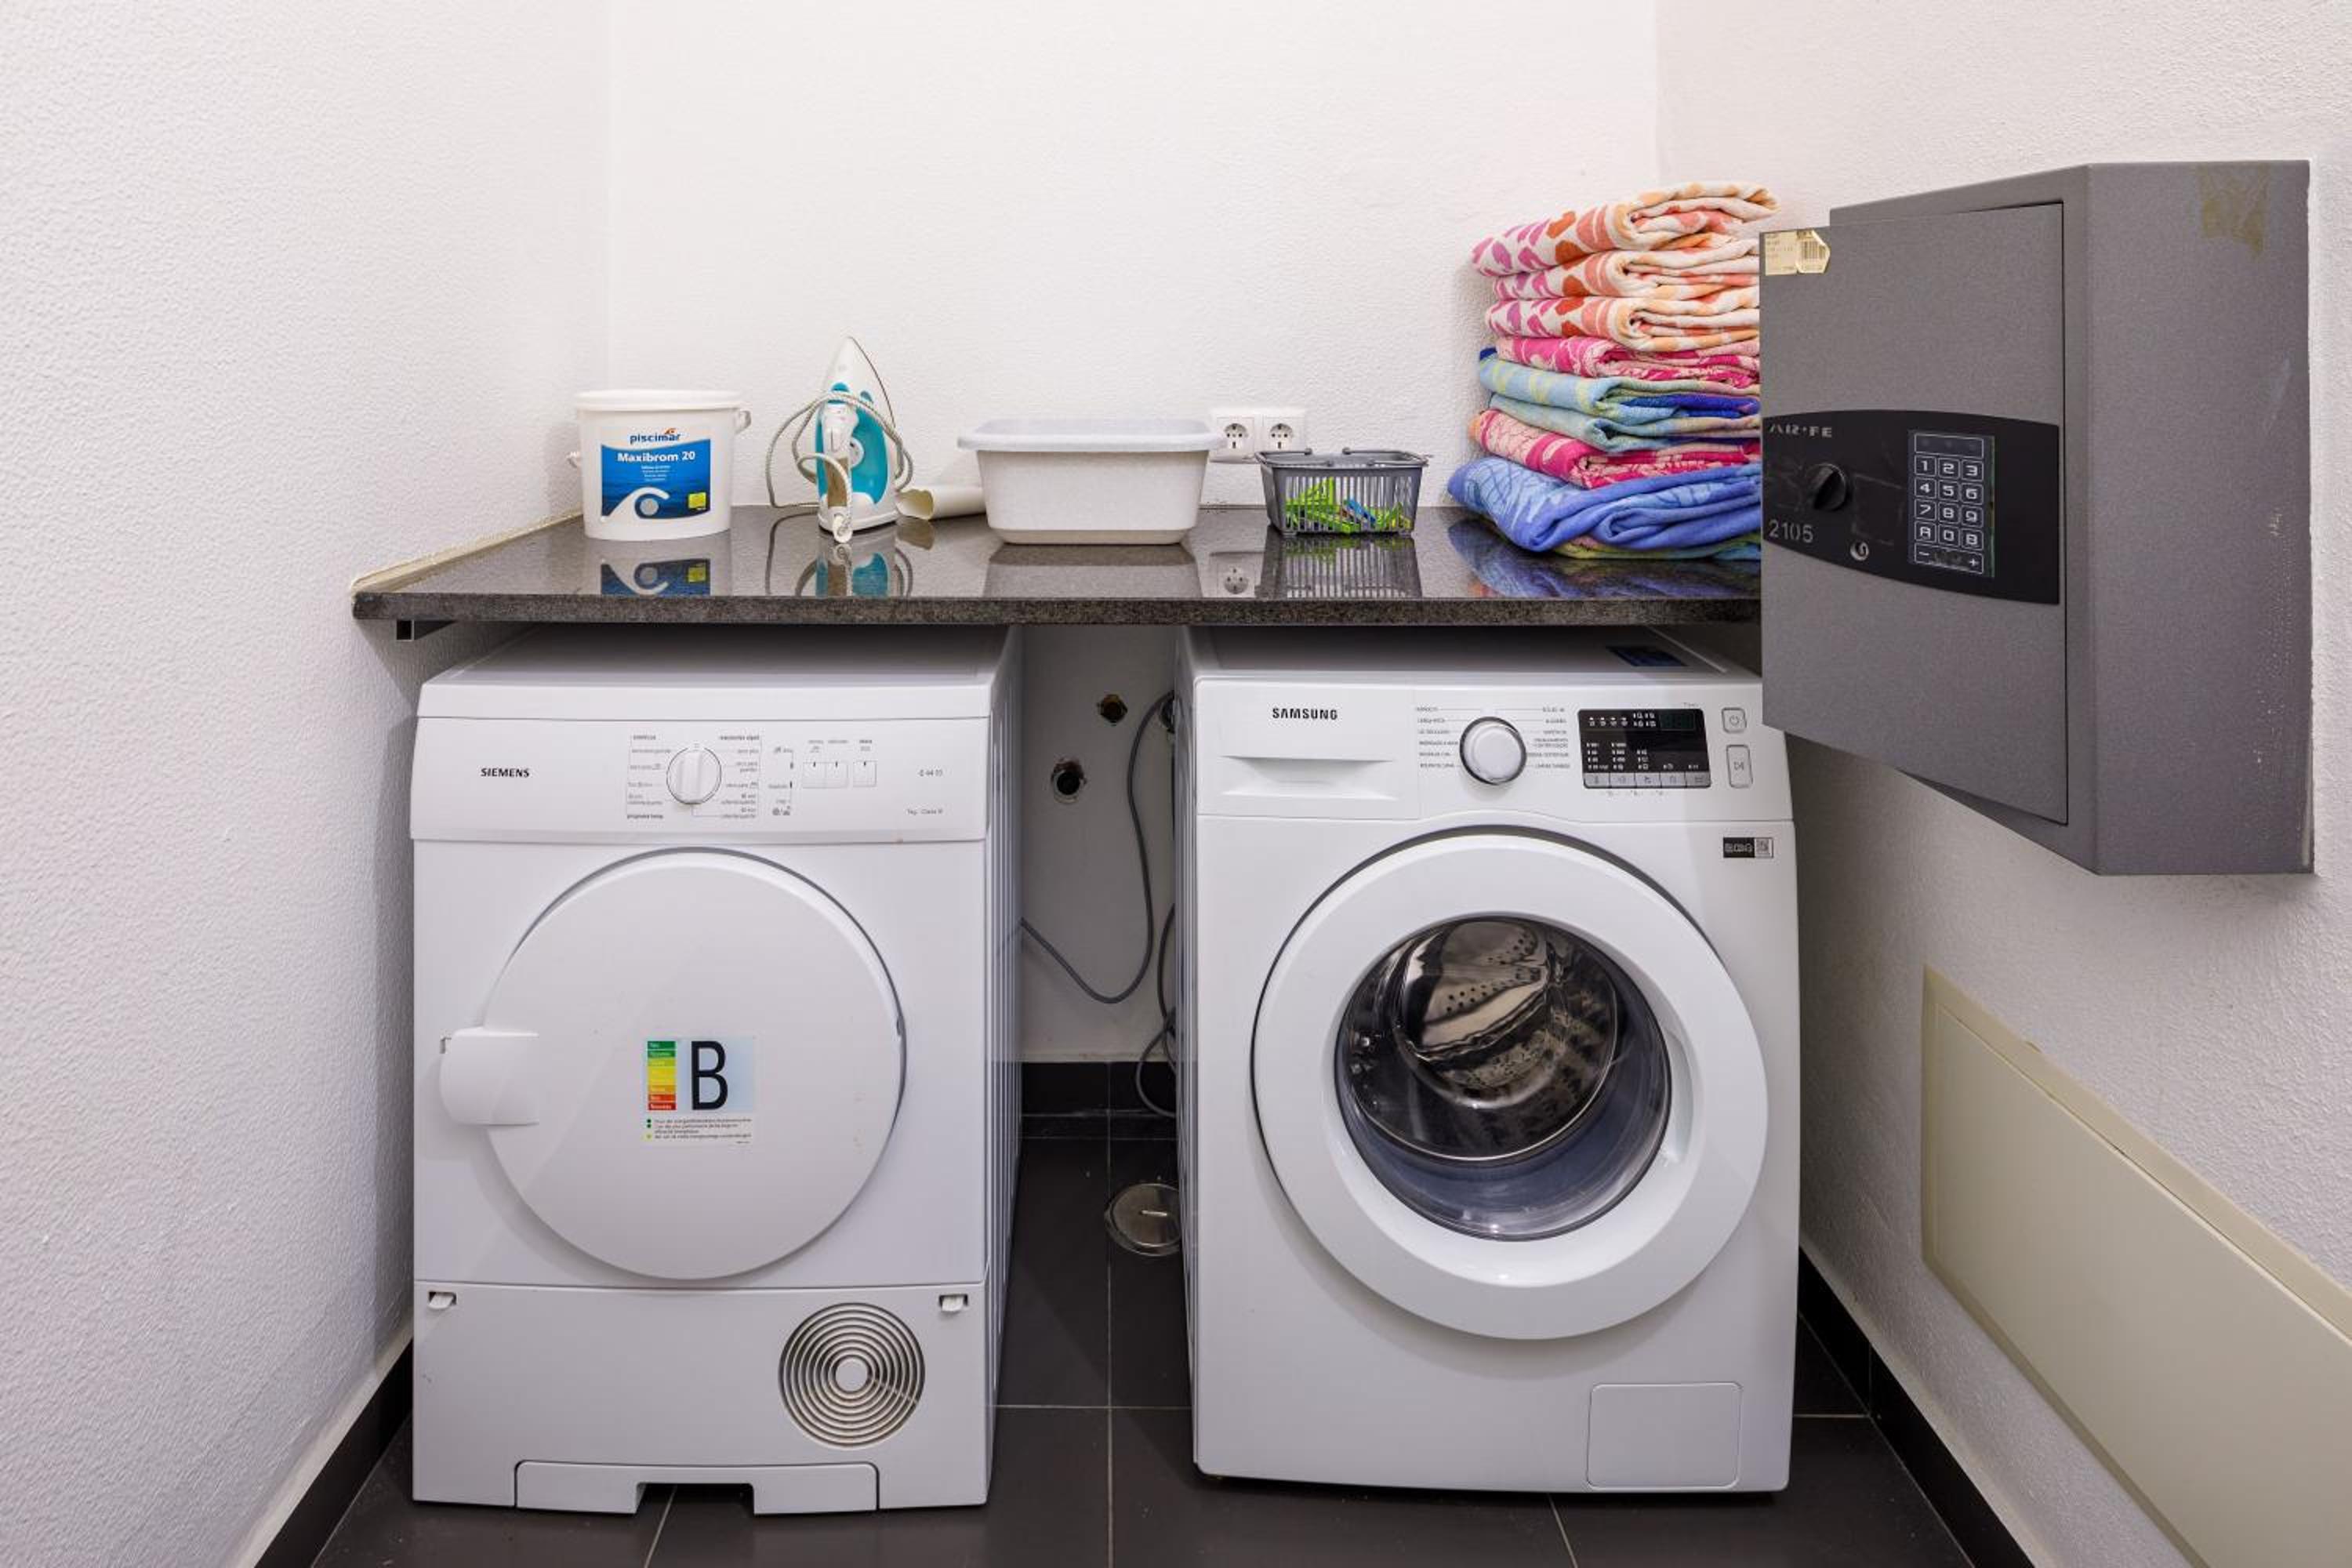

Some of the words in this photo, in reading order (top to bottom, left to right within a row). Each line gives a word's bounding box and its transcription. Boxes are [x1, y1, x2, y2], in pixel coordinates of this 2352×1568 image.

[630, 433, 681, 445] piscimar
[617, 452, 678, 462] Maxibrom
[681, 451, 695, 460] 20
[1921, 460, 1928, 471] 1
[1943, 463, 1955, 474] 2
[1965, 465, 1978, 477] 3
[1919, 483, 1930, 494] 4
[1943, 485, 1955, 496] 5
[1965, 488, 1978, 499] 6
[1919, 504, 1931, 515] 7
[1943, 507, 1955, 518] 8
[1965, 510, 1978, 523] 9
[1272, 707, 1338, 720] SAMSUNG
[480, 768, 530, 778] SIEMENS
[691, 1040, 728, 1111] B
